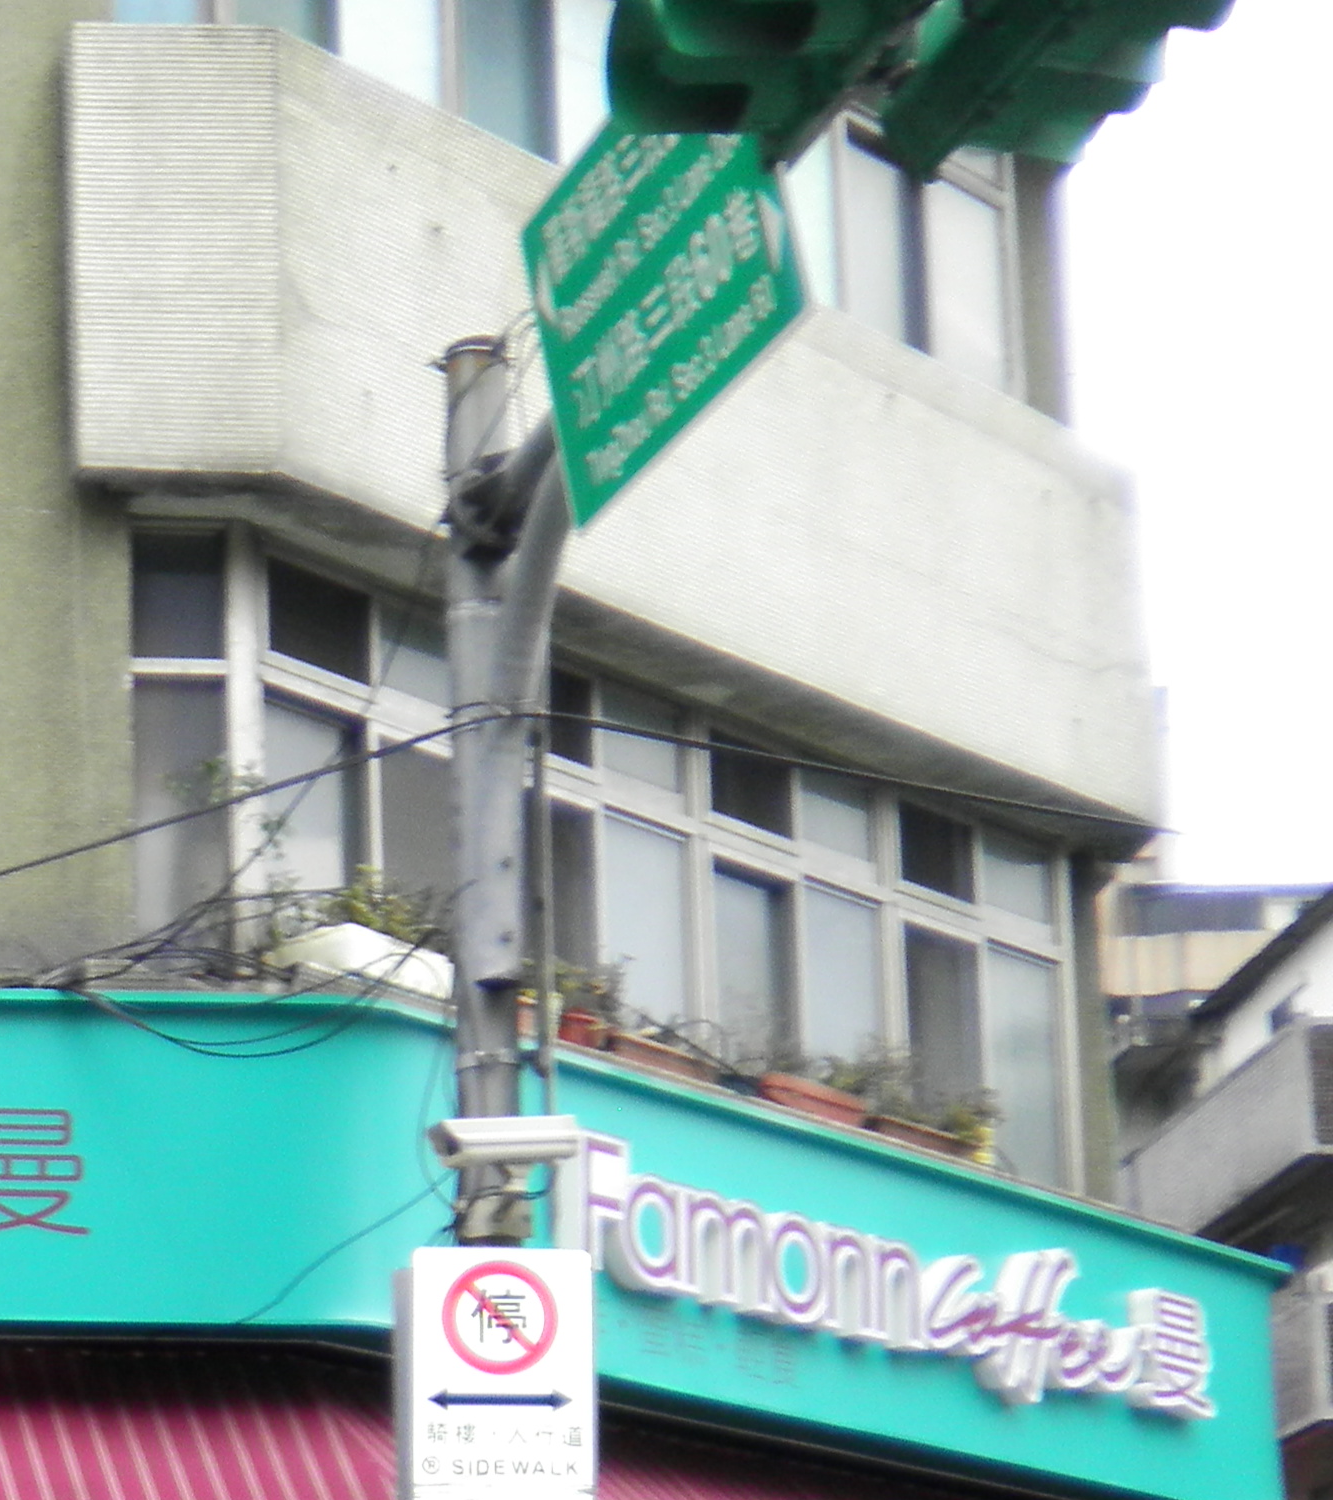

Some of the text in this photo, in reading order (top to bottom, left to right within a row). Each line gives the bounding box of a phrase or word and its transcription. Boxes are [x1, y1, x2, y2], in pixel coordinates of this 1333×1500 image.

[573, 1133, 925, 1350] Famonn
[1127, 1287, 1216, 1420] 曼
[470, 1288, 527, 1344] 停
[452, 1458, 579, 1476] SIDEWALK
